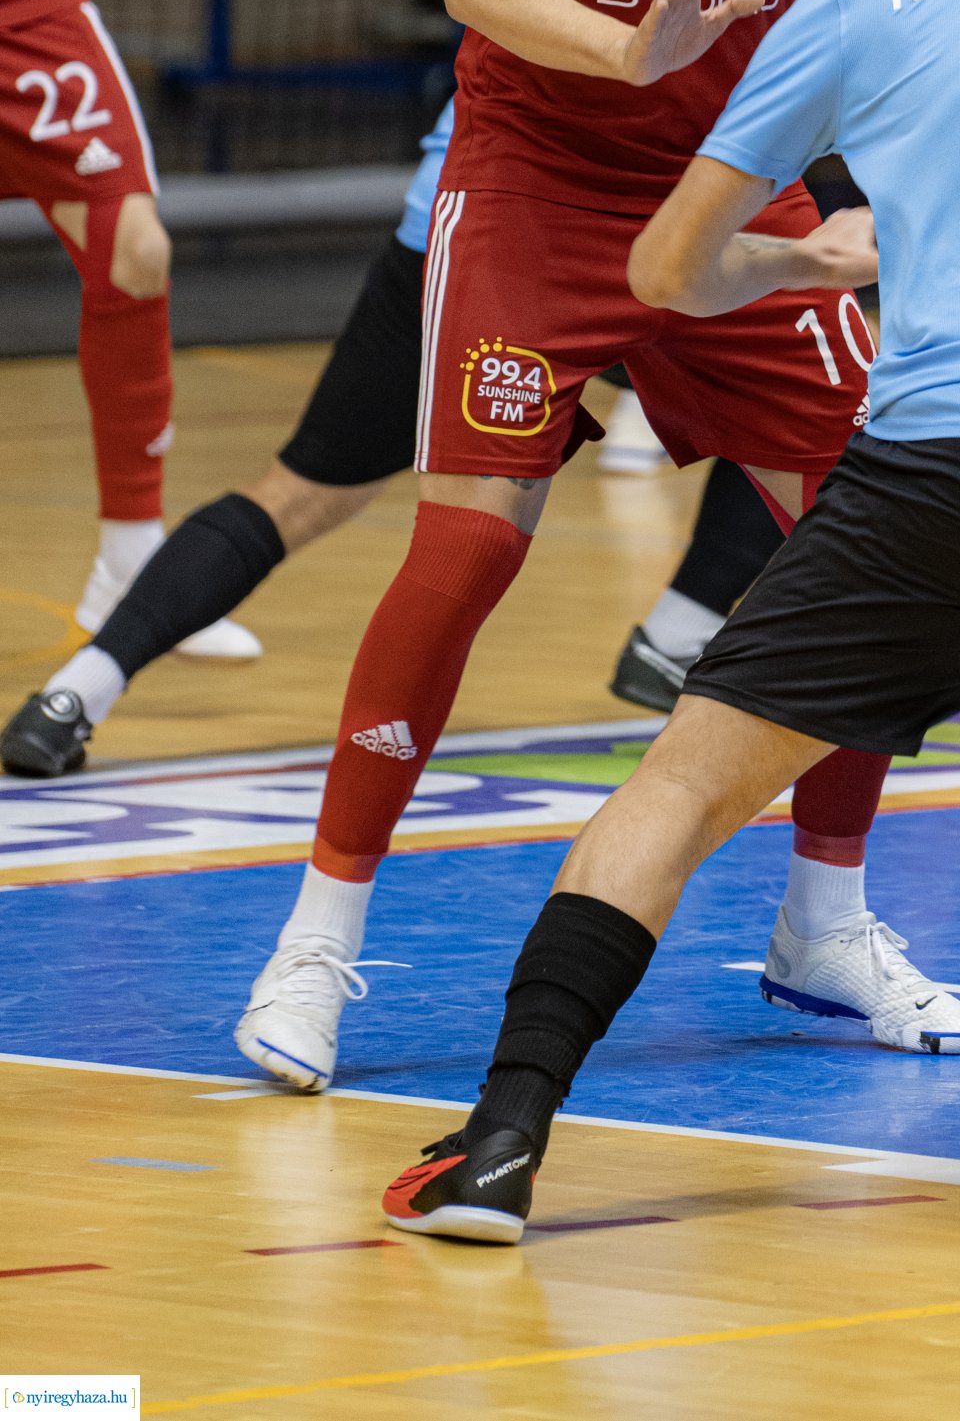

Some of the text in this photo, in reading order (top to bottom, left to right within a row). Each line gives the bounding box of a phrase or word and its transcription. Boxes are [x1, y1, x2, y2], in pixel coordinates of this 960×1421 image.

[16, 60, 112, 142] 22
[795, 293, 877, 386] 10
[481, 357, 541, 391] 99.4
[477, 384, 541, 404] SUNSHINE
[490, 400, 524, 423] FM
[350, 732, 418, 760] adidas
